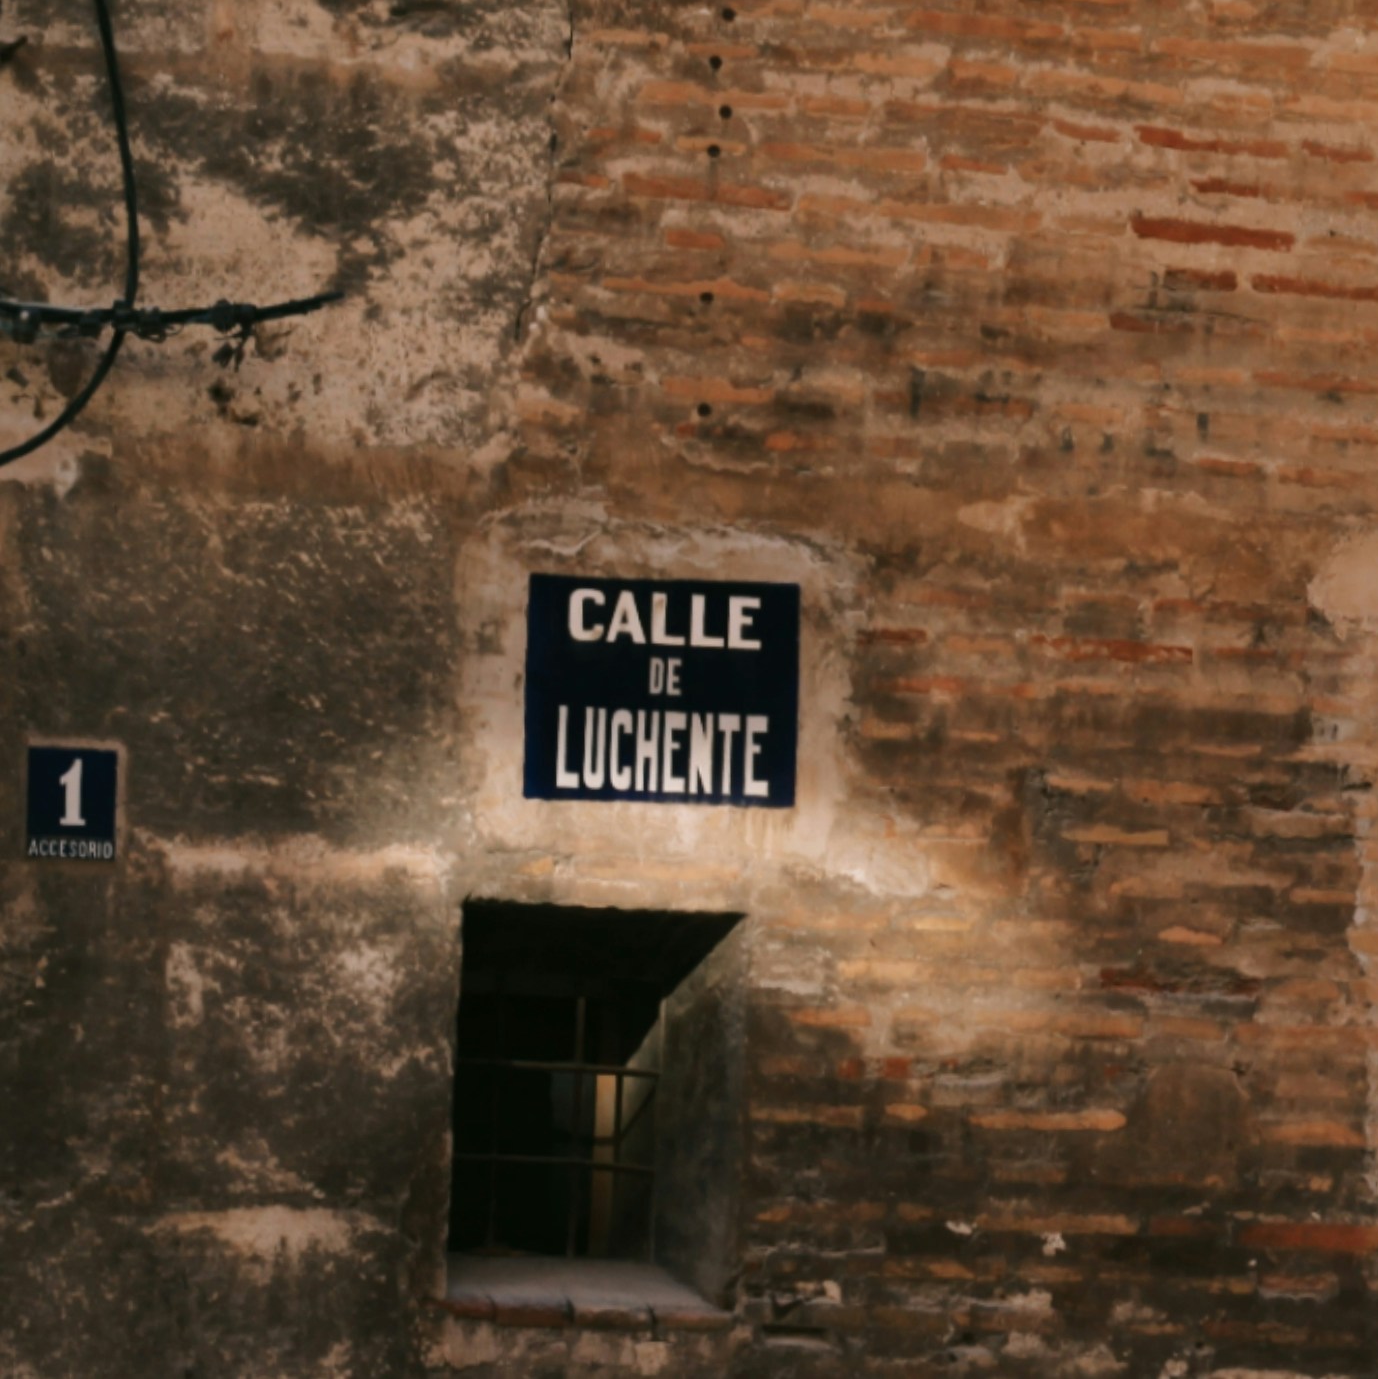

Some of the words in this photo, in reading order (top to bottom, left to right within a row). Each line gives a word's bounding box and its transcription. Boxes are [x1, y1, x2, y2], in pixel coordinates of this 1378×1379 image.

[567, 587, 763, 651] CALLE
[648, 656, 683, 697] DE
[555, 704, 770, 798] LUCHENTE
[59, 757, 86, 827] 1
[28, 838, 113, 859] ACCESORIO
